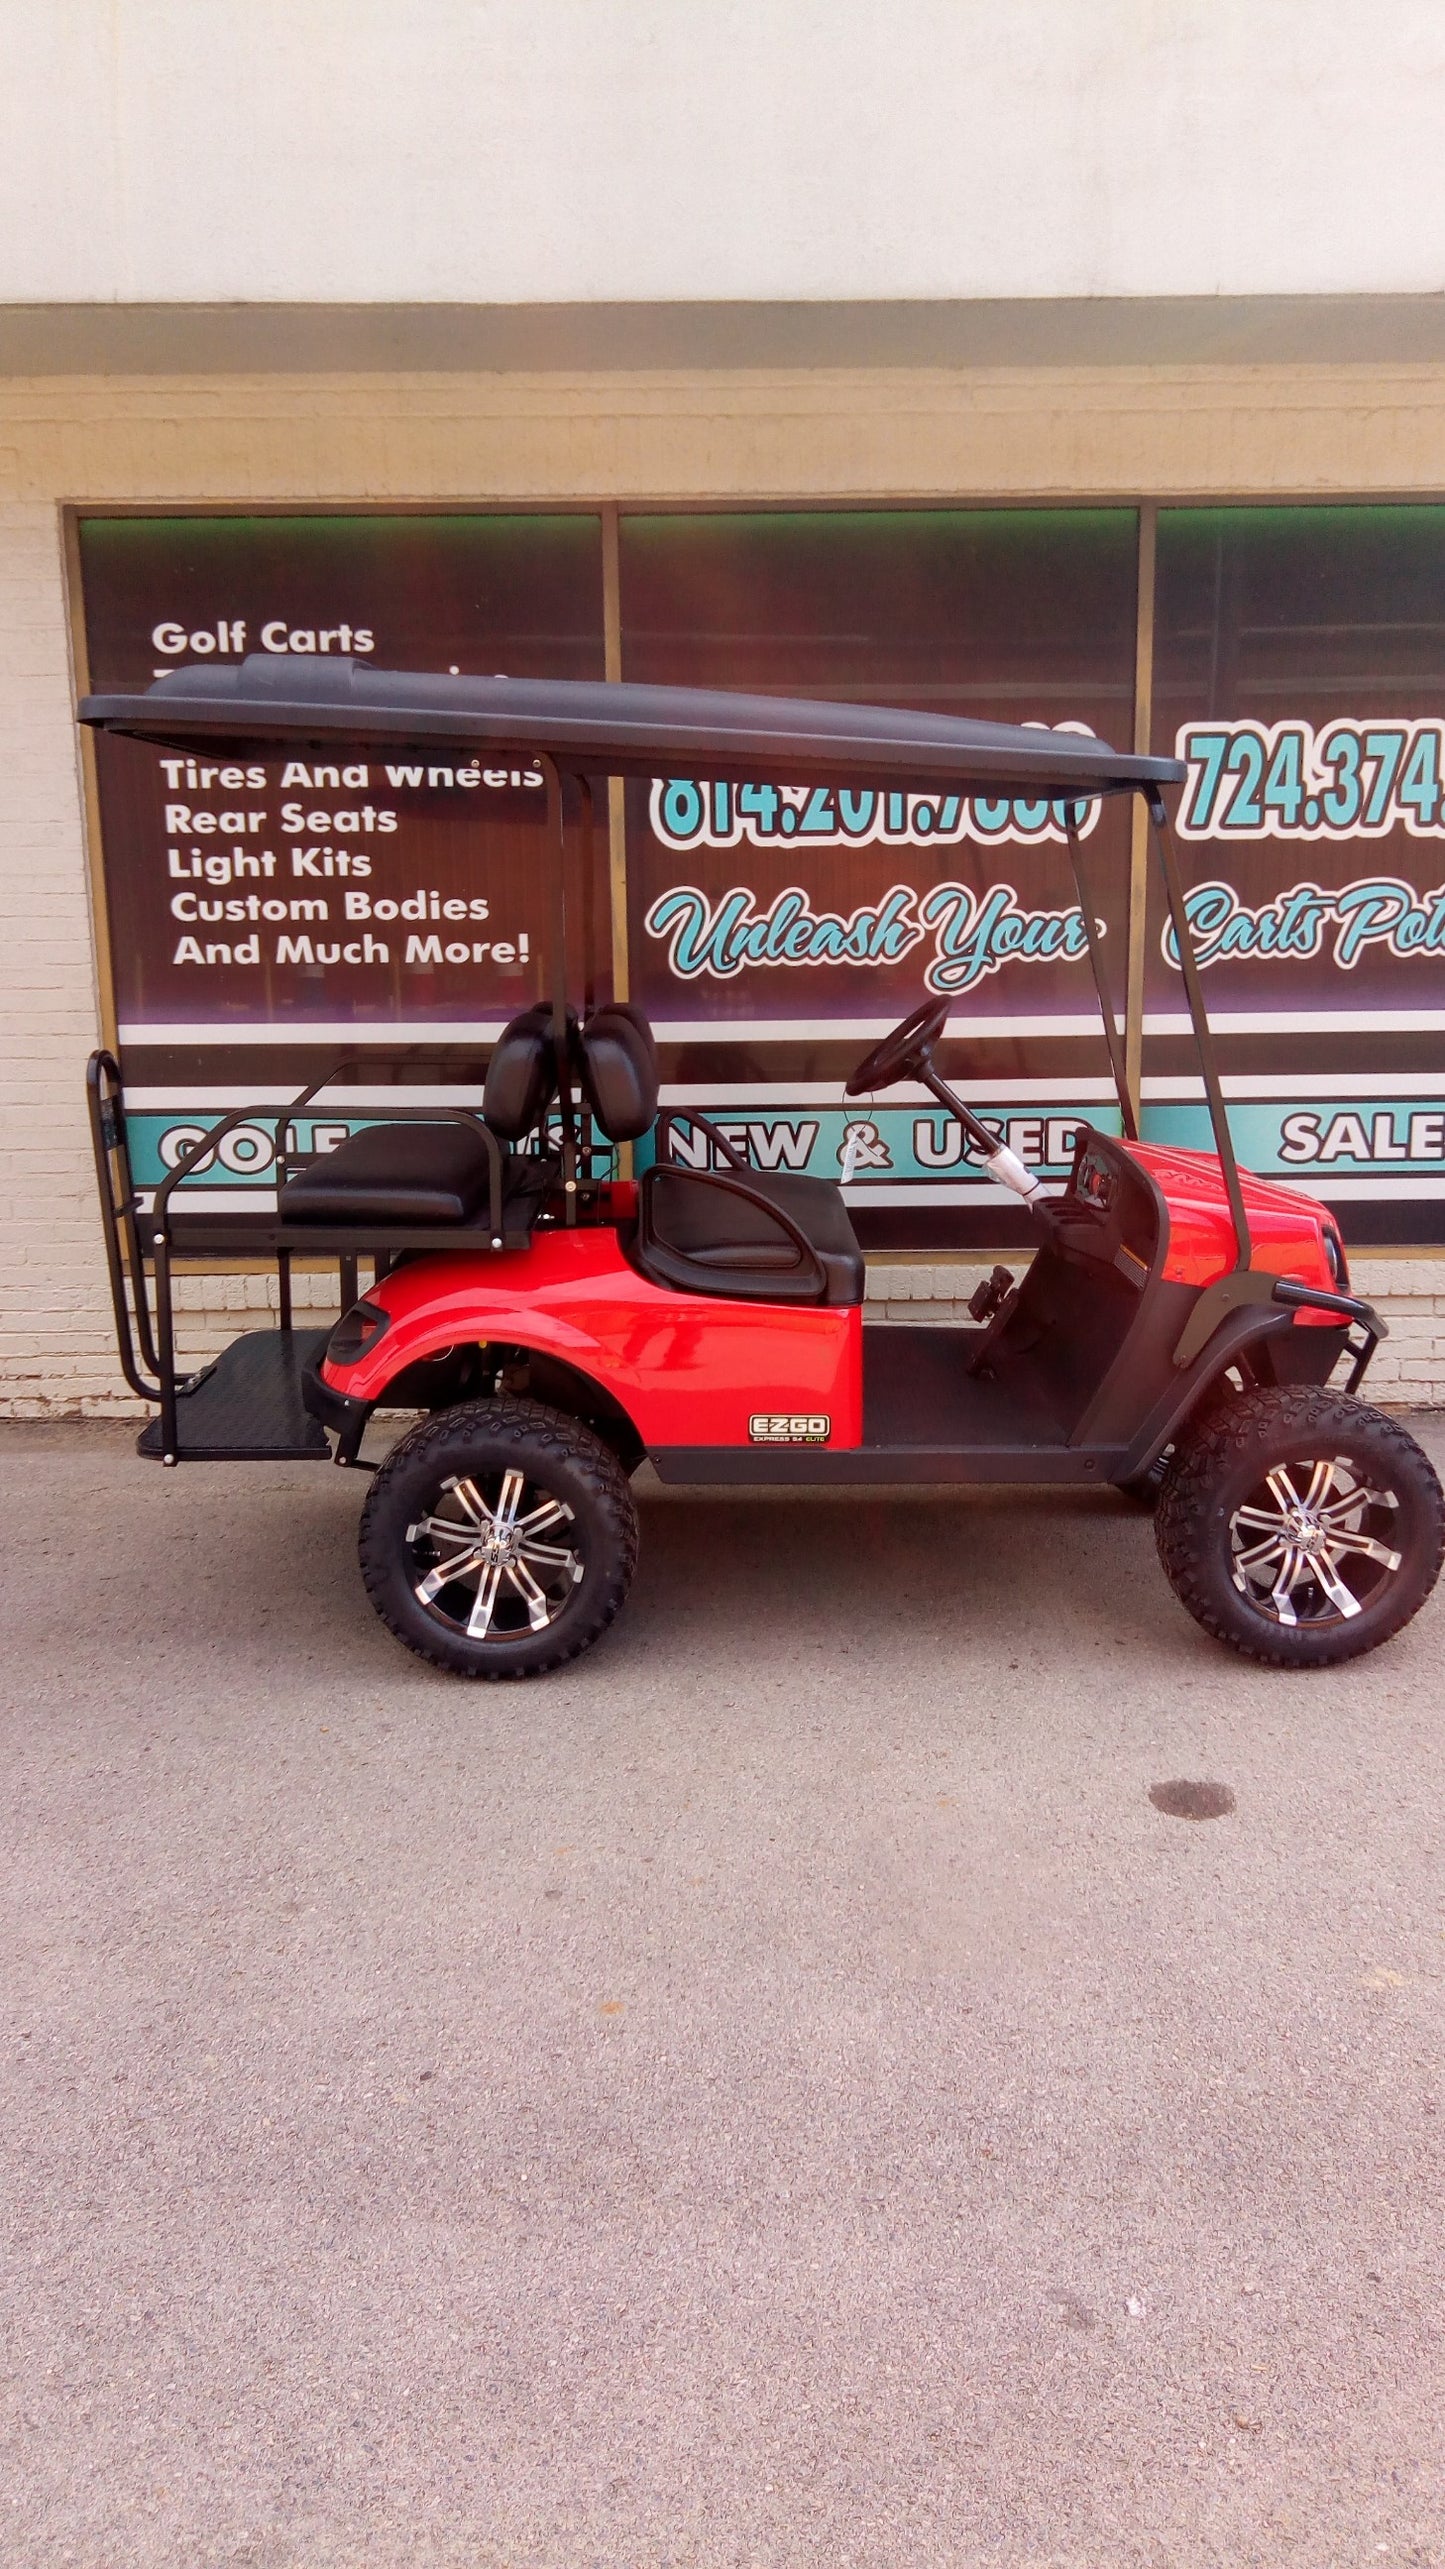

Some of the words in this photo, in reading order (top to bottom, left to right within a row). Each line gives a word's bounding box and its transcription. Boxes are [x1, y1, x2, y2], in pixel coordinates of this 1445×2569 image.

[152, 620, 246, 654] Golf
[261, 620, 375, 653] Carts
[159, 758, 267, 789] Tires
[280, 762, 369, 788] And
[165, 804, 267, 834] Rear
[281, 803, 398, 833] Seats
[168, 846, 277, 885] Light
[291, 846, 372, 877] Kits
[171, 892, 328, 922] Custom
[344, 889, 489, 921] Bodies
[645, 885, 925, 980] Unleash
[918, 881, 1106, 996] Your
[1161, 880, 1338, 970] Carts
[1333, 877, 1445, 970] Pot
[173, 934, 260, 965] And
[276, 933, 389, 964] Much
[405, 933, 529, 964] More!
[667, 1120, 820, 1170] NEW
[836, 1120, 894, 1170] &
[913, 1117, 1094, 1169] USED
